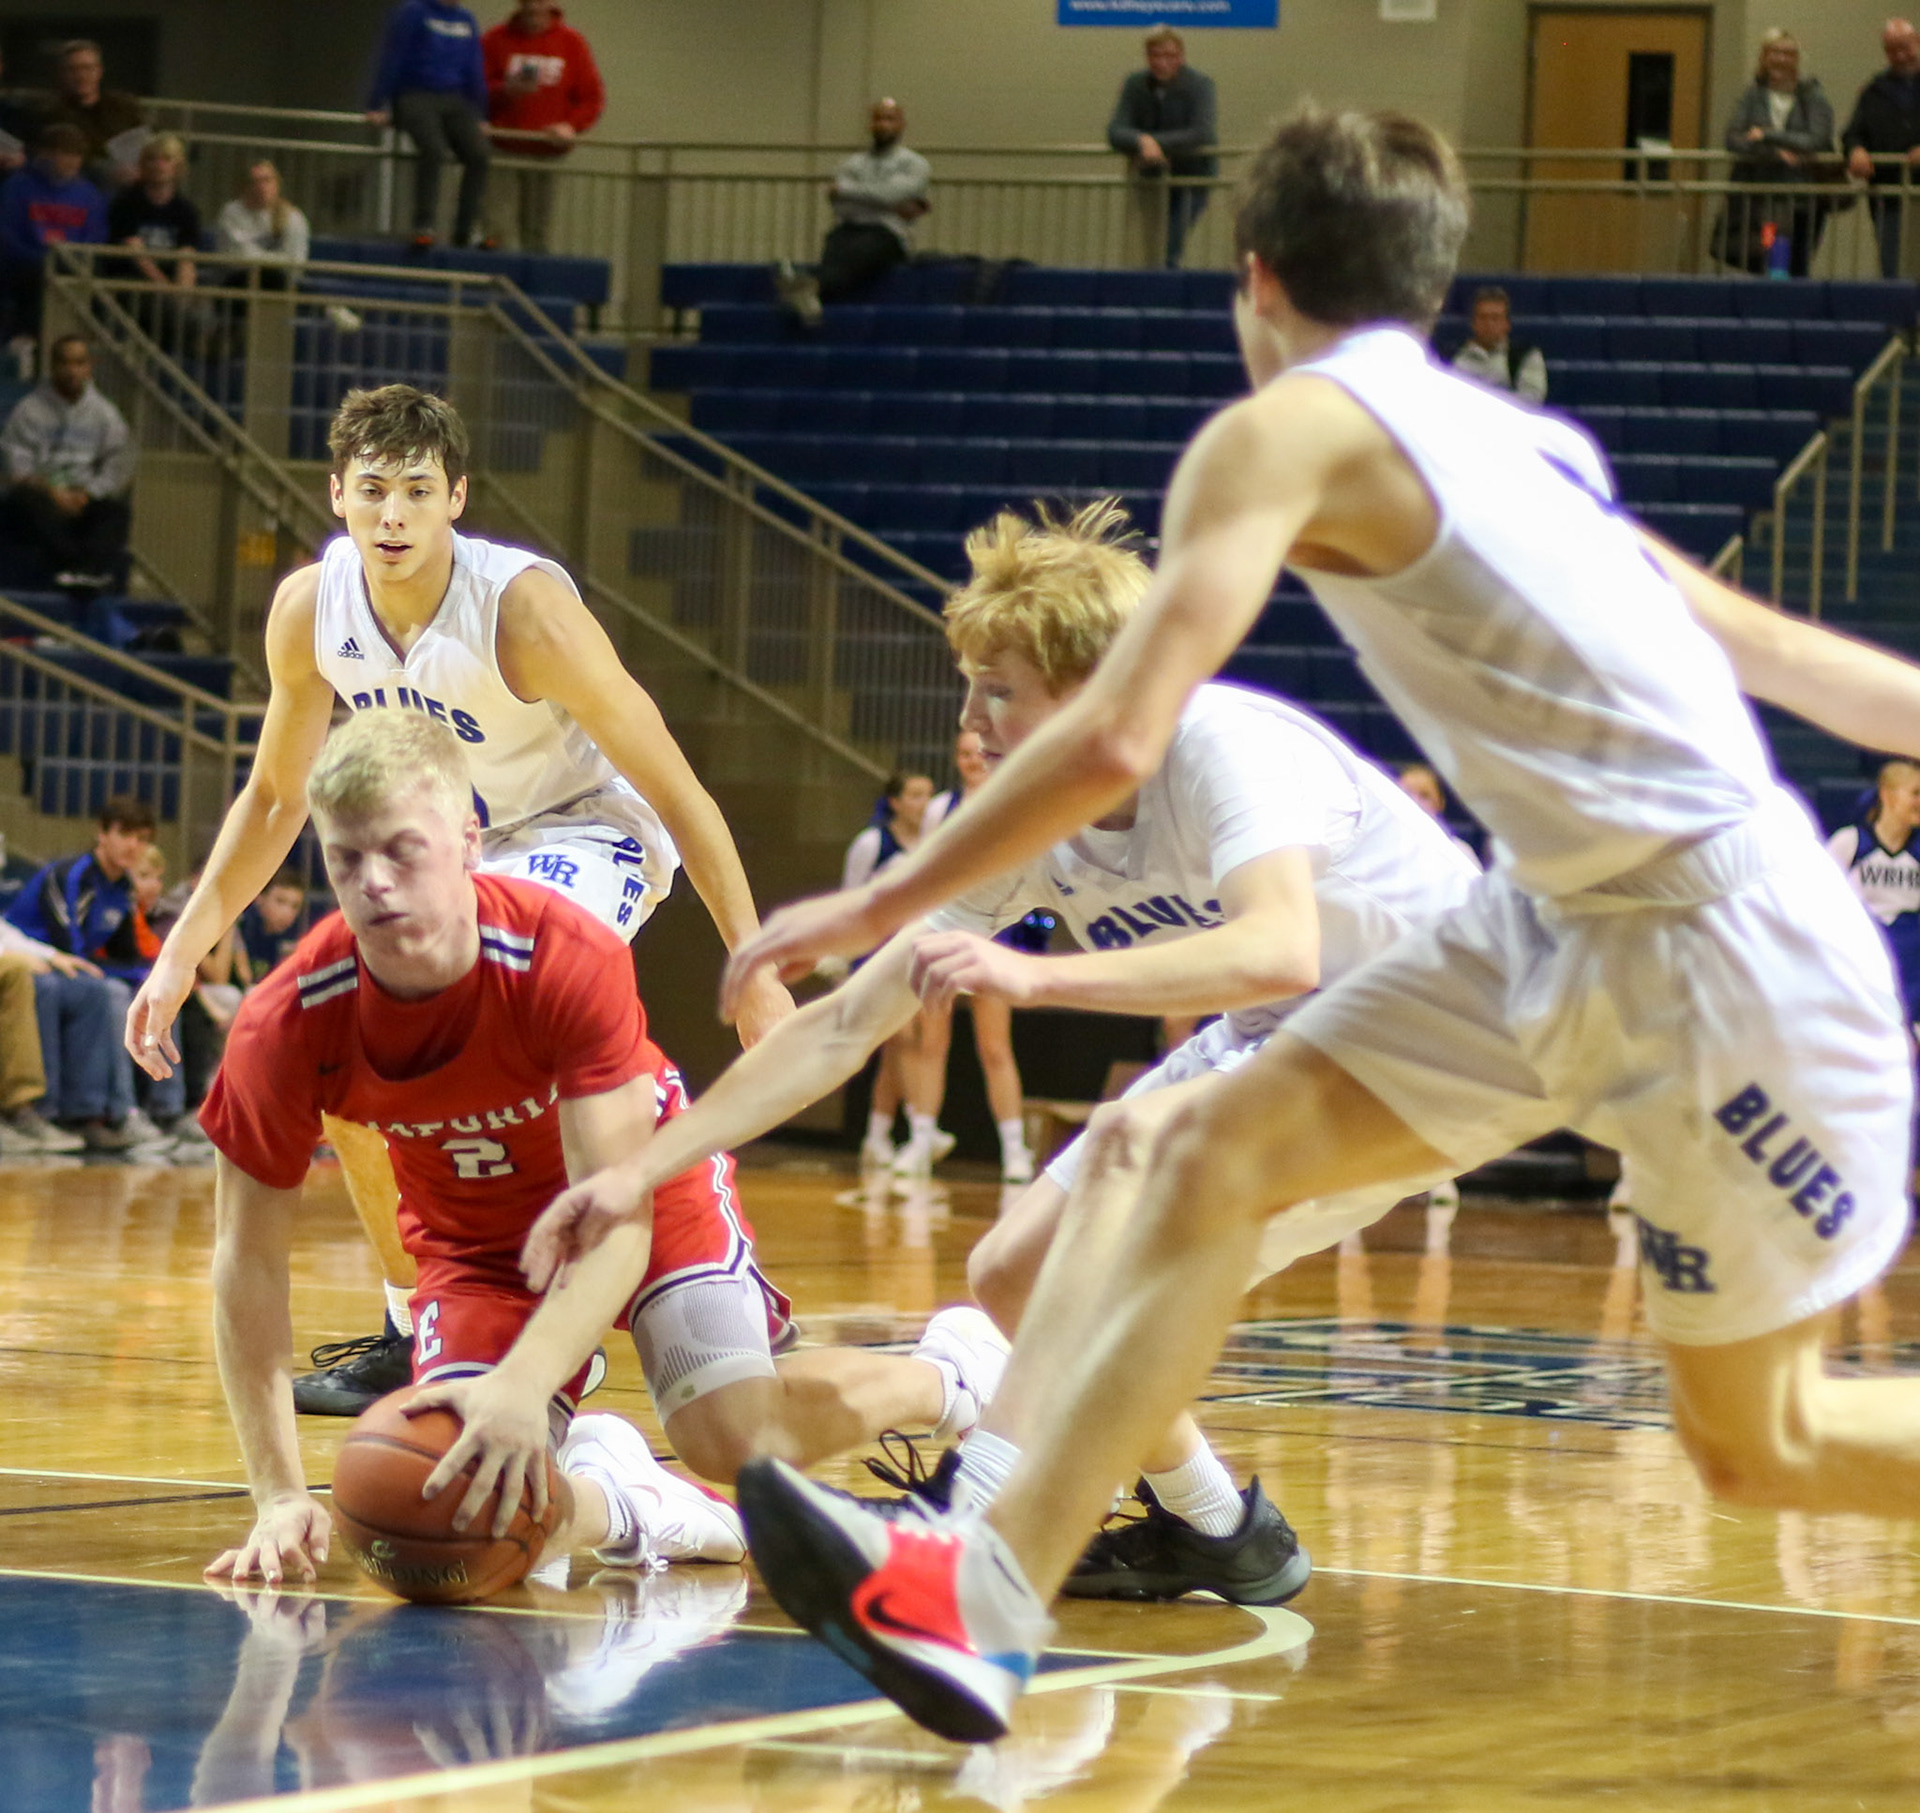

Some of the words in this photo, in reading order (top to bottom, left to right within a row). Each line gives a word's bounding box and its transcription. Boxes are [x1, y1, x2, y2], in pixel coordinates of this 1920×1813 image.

[337, 650, 365, 660] adidas
[527, 853, 581, 890] WR
[612, 836, 645, 926] BLES
[440, 1137, 515, 1179] 2
[1713, 1081, 1856, 1241] BLUES
[417, 1300, 443, 1367] E
